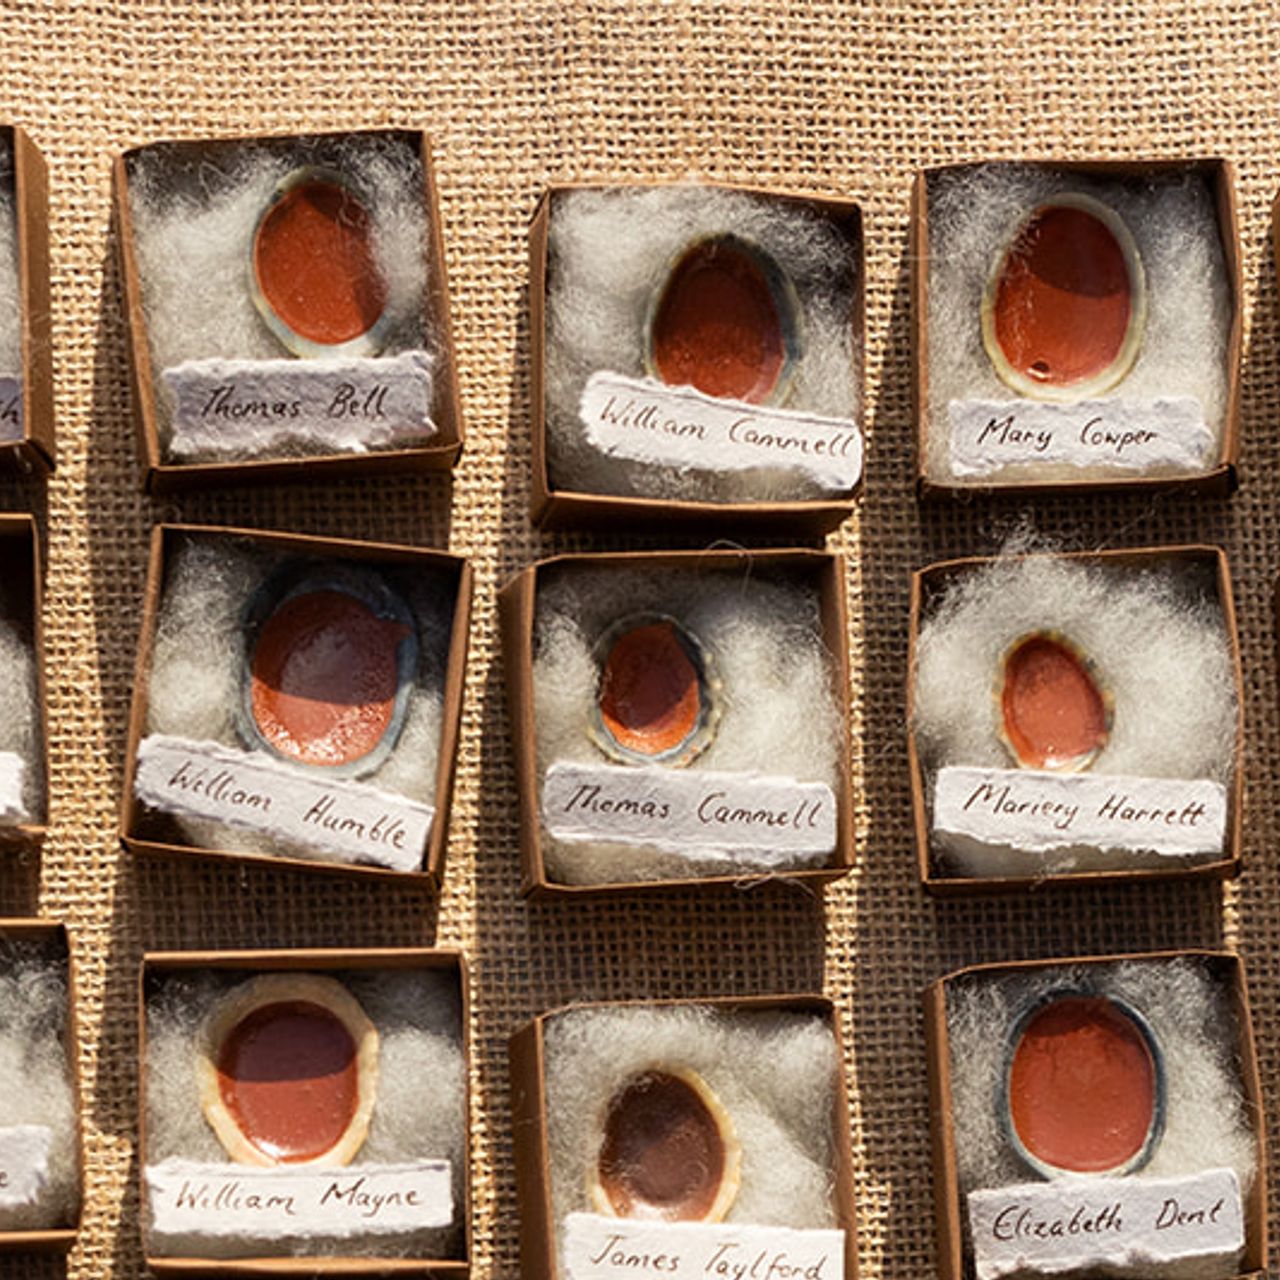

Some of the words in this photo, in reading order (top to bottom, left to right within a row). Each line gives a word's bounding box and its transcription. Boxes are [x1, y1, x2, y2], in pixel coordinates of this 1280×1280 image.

[204, 386, 299, 419] Thomas
[329, 385, 384, 417] Bell
[600, 399, 704, 439] William
[728, 417, 851, 456] Cammell
[978, 417, 1051, 451] Mary
[1080, 419, 1156, 451] Cowper
[168, 763, 272, 811] William
[304, 796, 406, 849] Humble
[565, 784, 670, 818] Thomas
[697, 792, 820, 828] Cammell
[176, 1183, 295, 1213] William
[320, 1182, 419, 1218] Mayne
[993, 1205, 1122, 1239] Elizabeth
[1156, 1200, 1222, 1230] Dent
[590, 1236, 678, 1272] James
